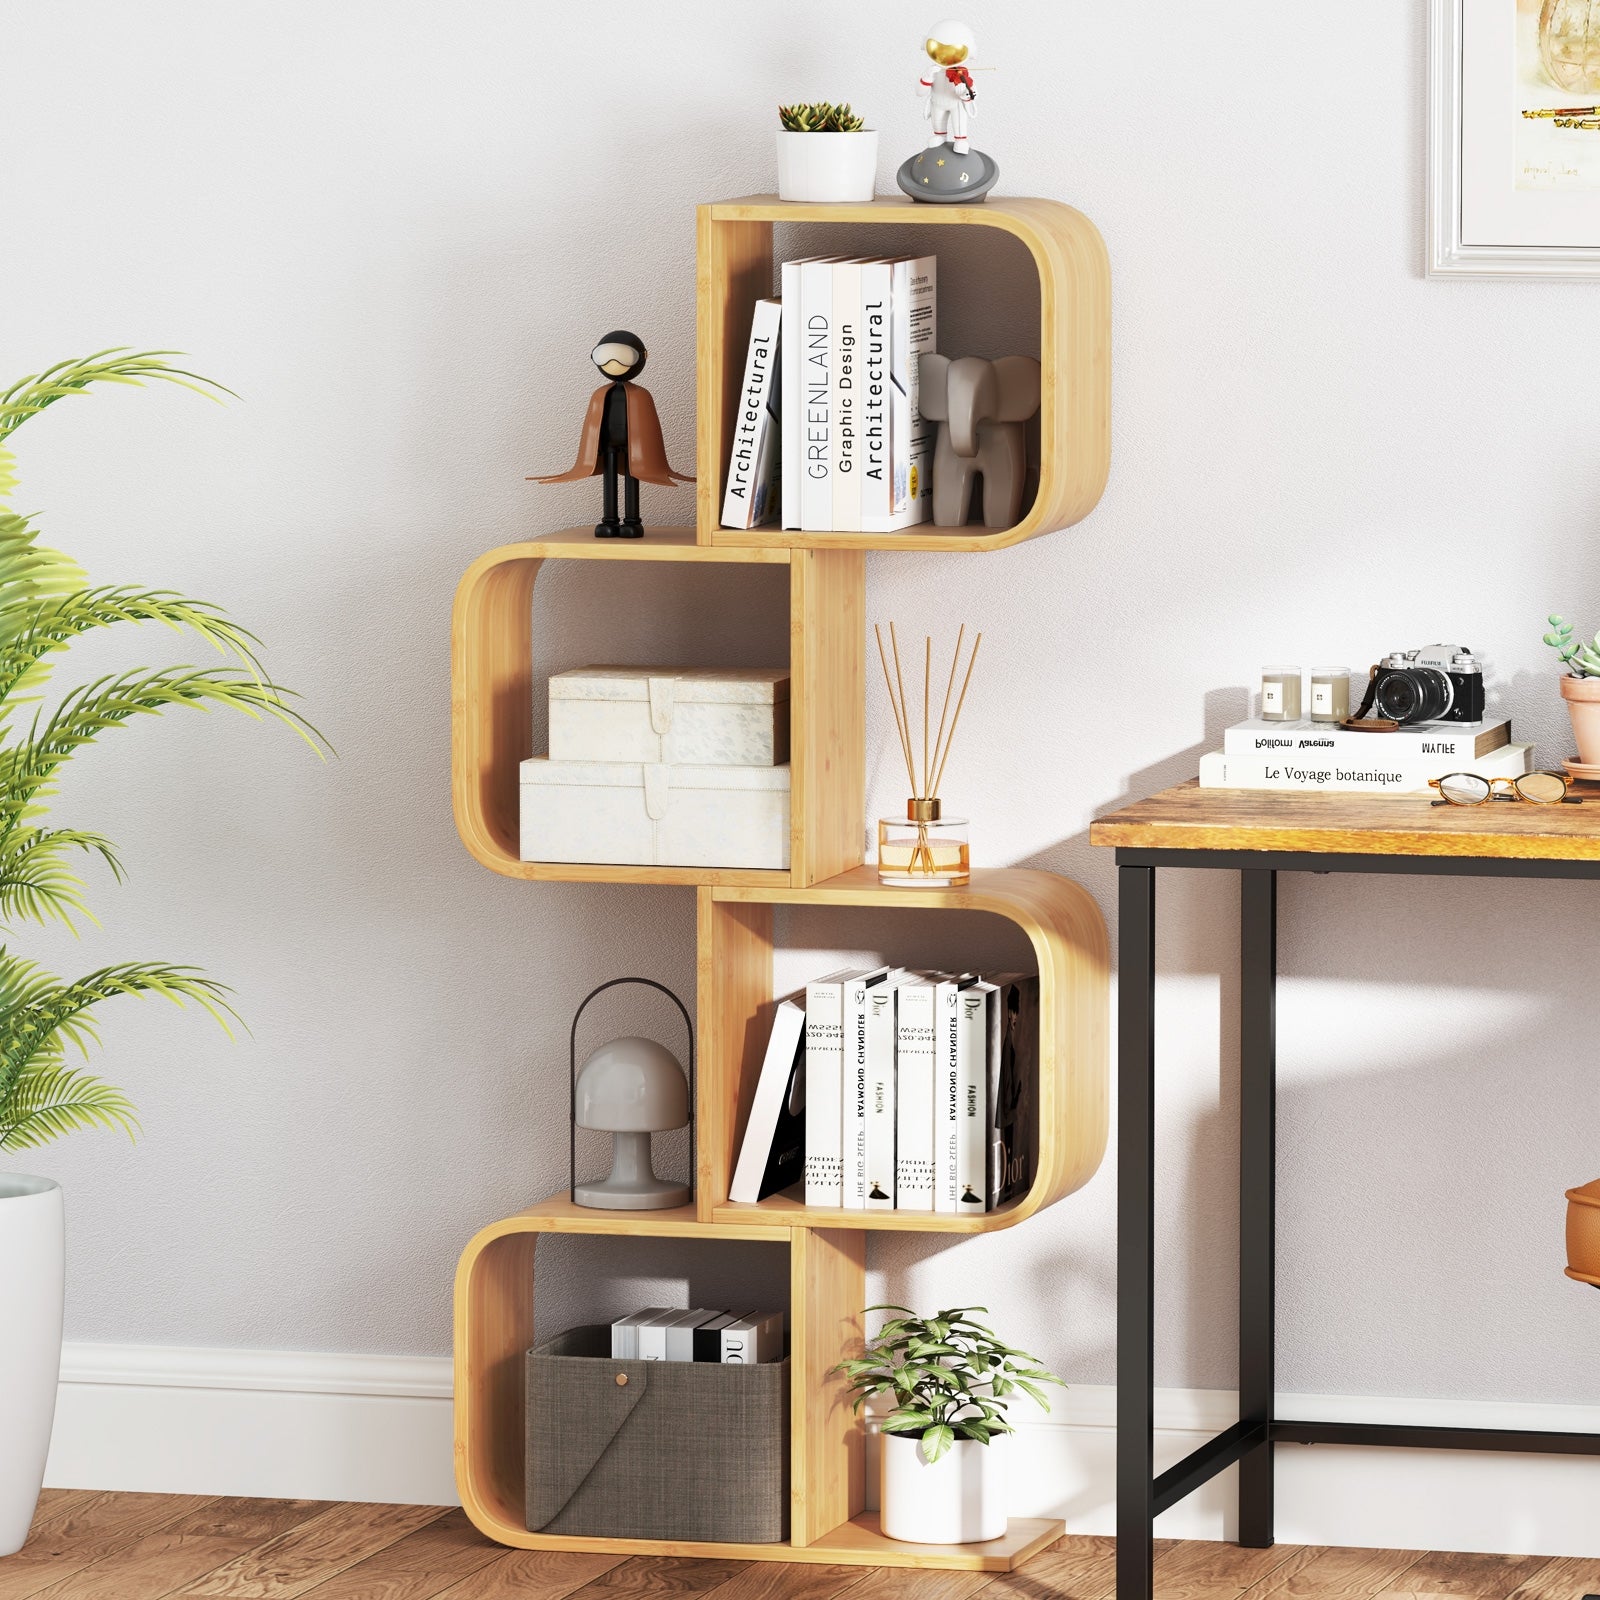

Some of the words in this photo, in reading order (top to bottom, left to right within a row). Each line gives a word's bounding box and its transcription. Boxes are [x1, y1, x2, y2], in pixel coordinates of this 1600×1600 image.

[839, 323, 856, 389] Design
[730, 336, 770, 499] Architectural
[808, 314, 829, 479] GREENLAND
[866, 301, 882, 480] Architectural
[839, 397, 856, 473] Graphic
[1264, 766, 1280, 779] Le
[1284, 766, 1332, 784] Voyage
[1336, 768, 1403, 786] botanique
[964, 998, 981, 1020] Dior
[875, 1082, 884, 1114] FASHION
[967, 1085, 976, 1118] FASHION
[992, 1140, 1025, 1195] Dior
